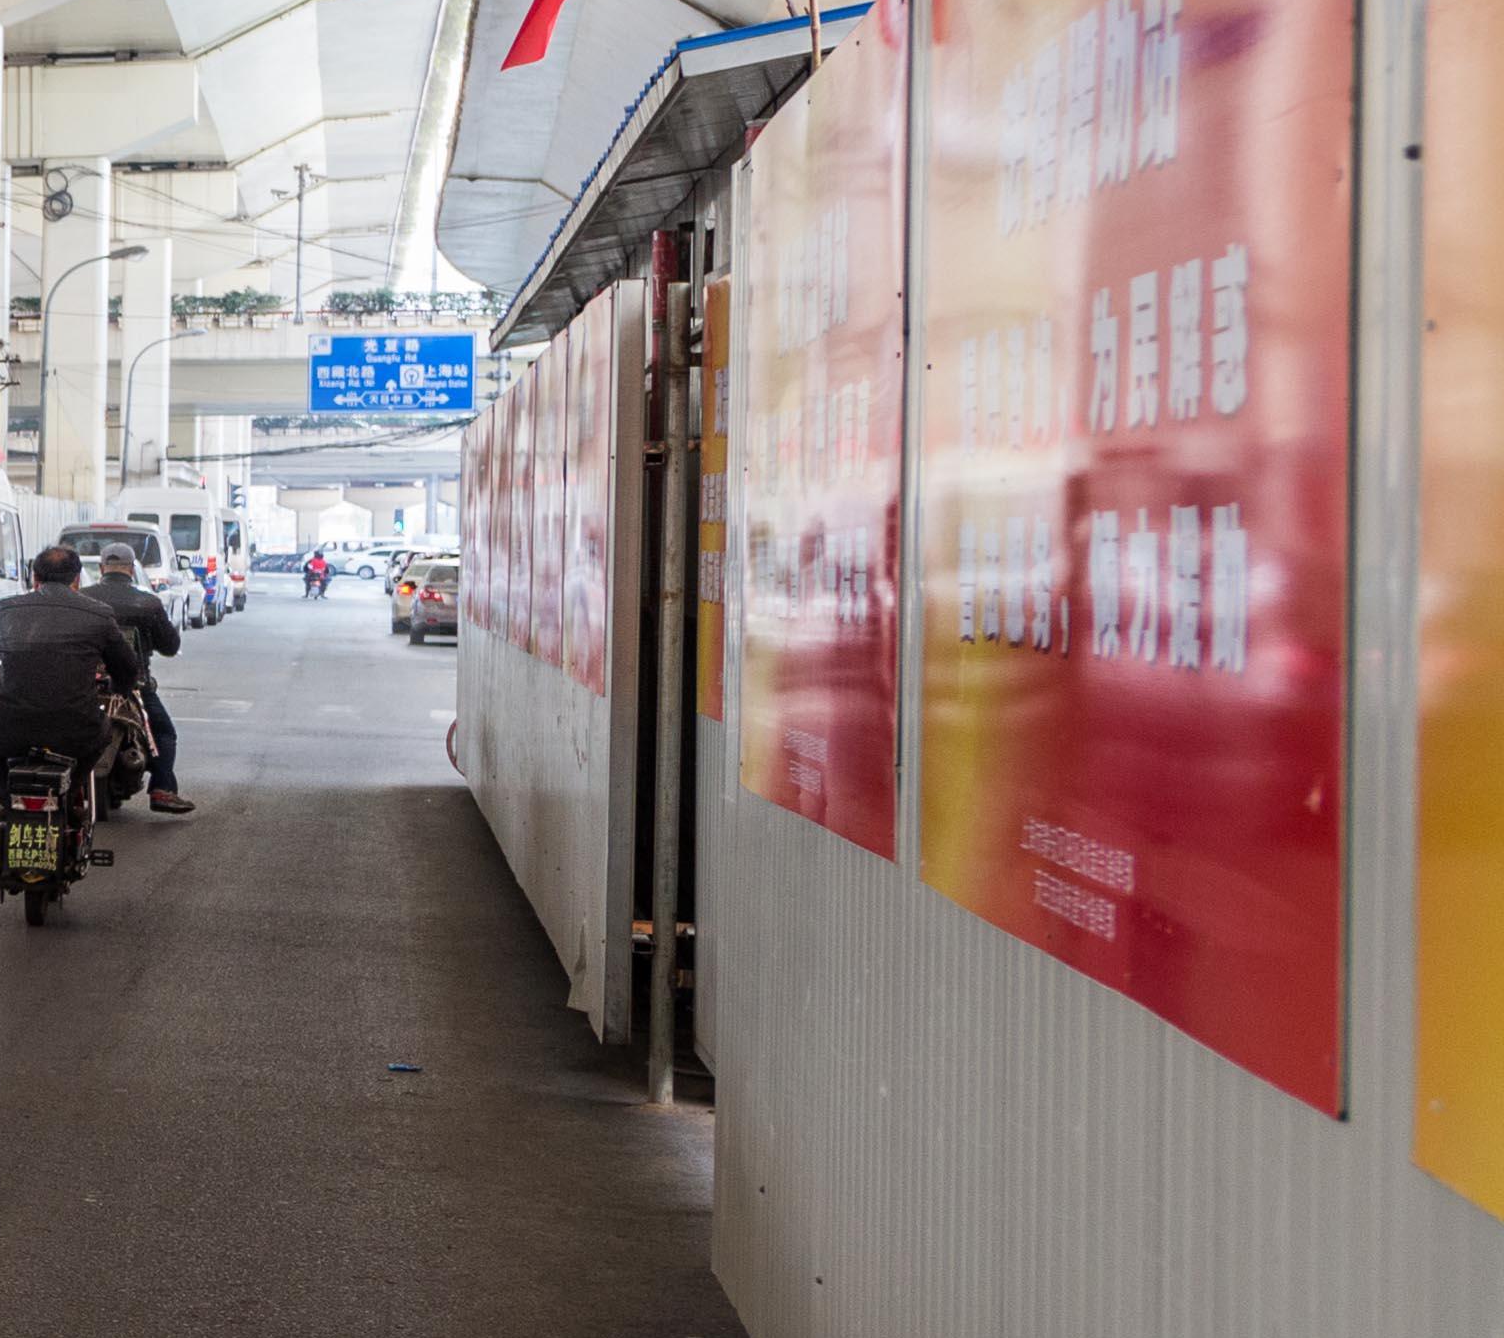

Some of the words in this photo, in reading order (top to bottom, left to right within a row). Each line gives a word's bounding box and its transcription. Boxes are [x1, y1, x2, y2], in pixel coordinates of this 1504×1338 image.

[364, 338, 420, 353] 光复路
[317, 364, 375, 379] 西藏北路
[424, 364, 468, 379] 上海站
